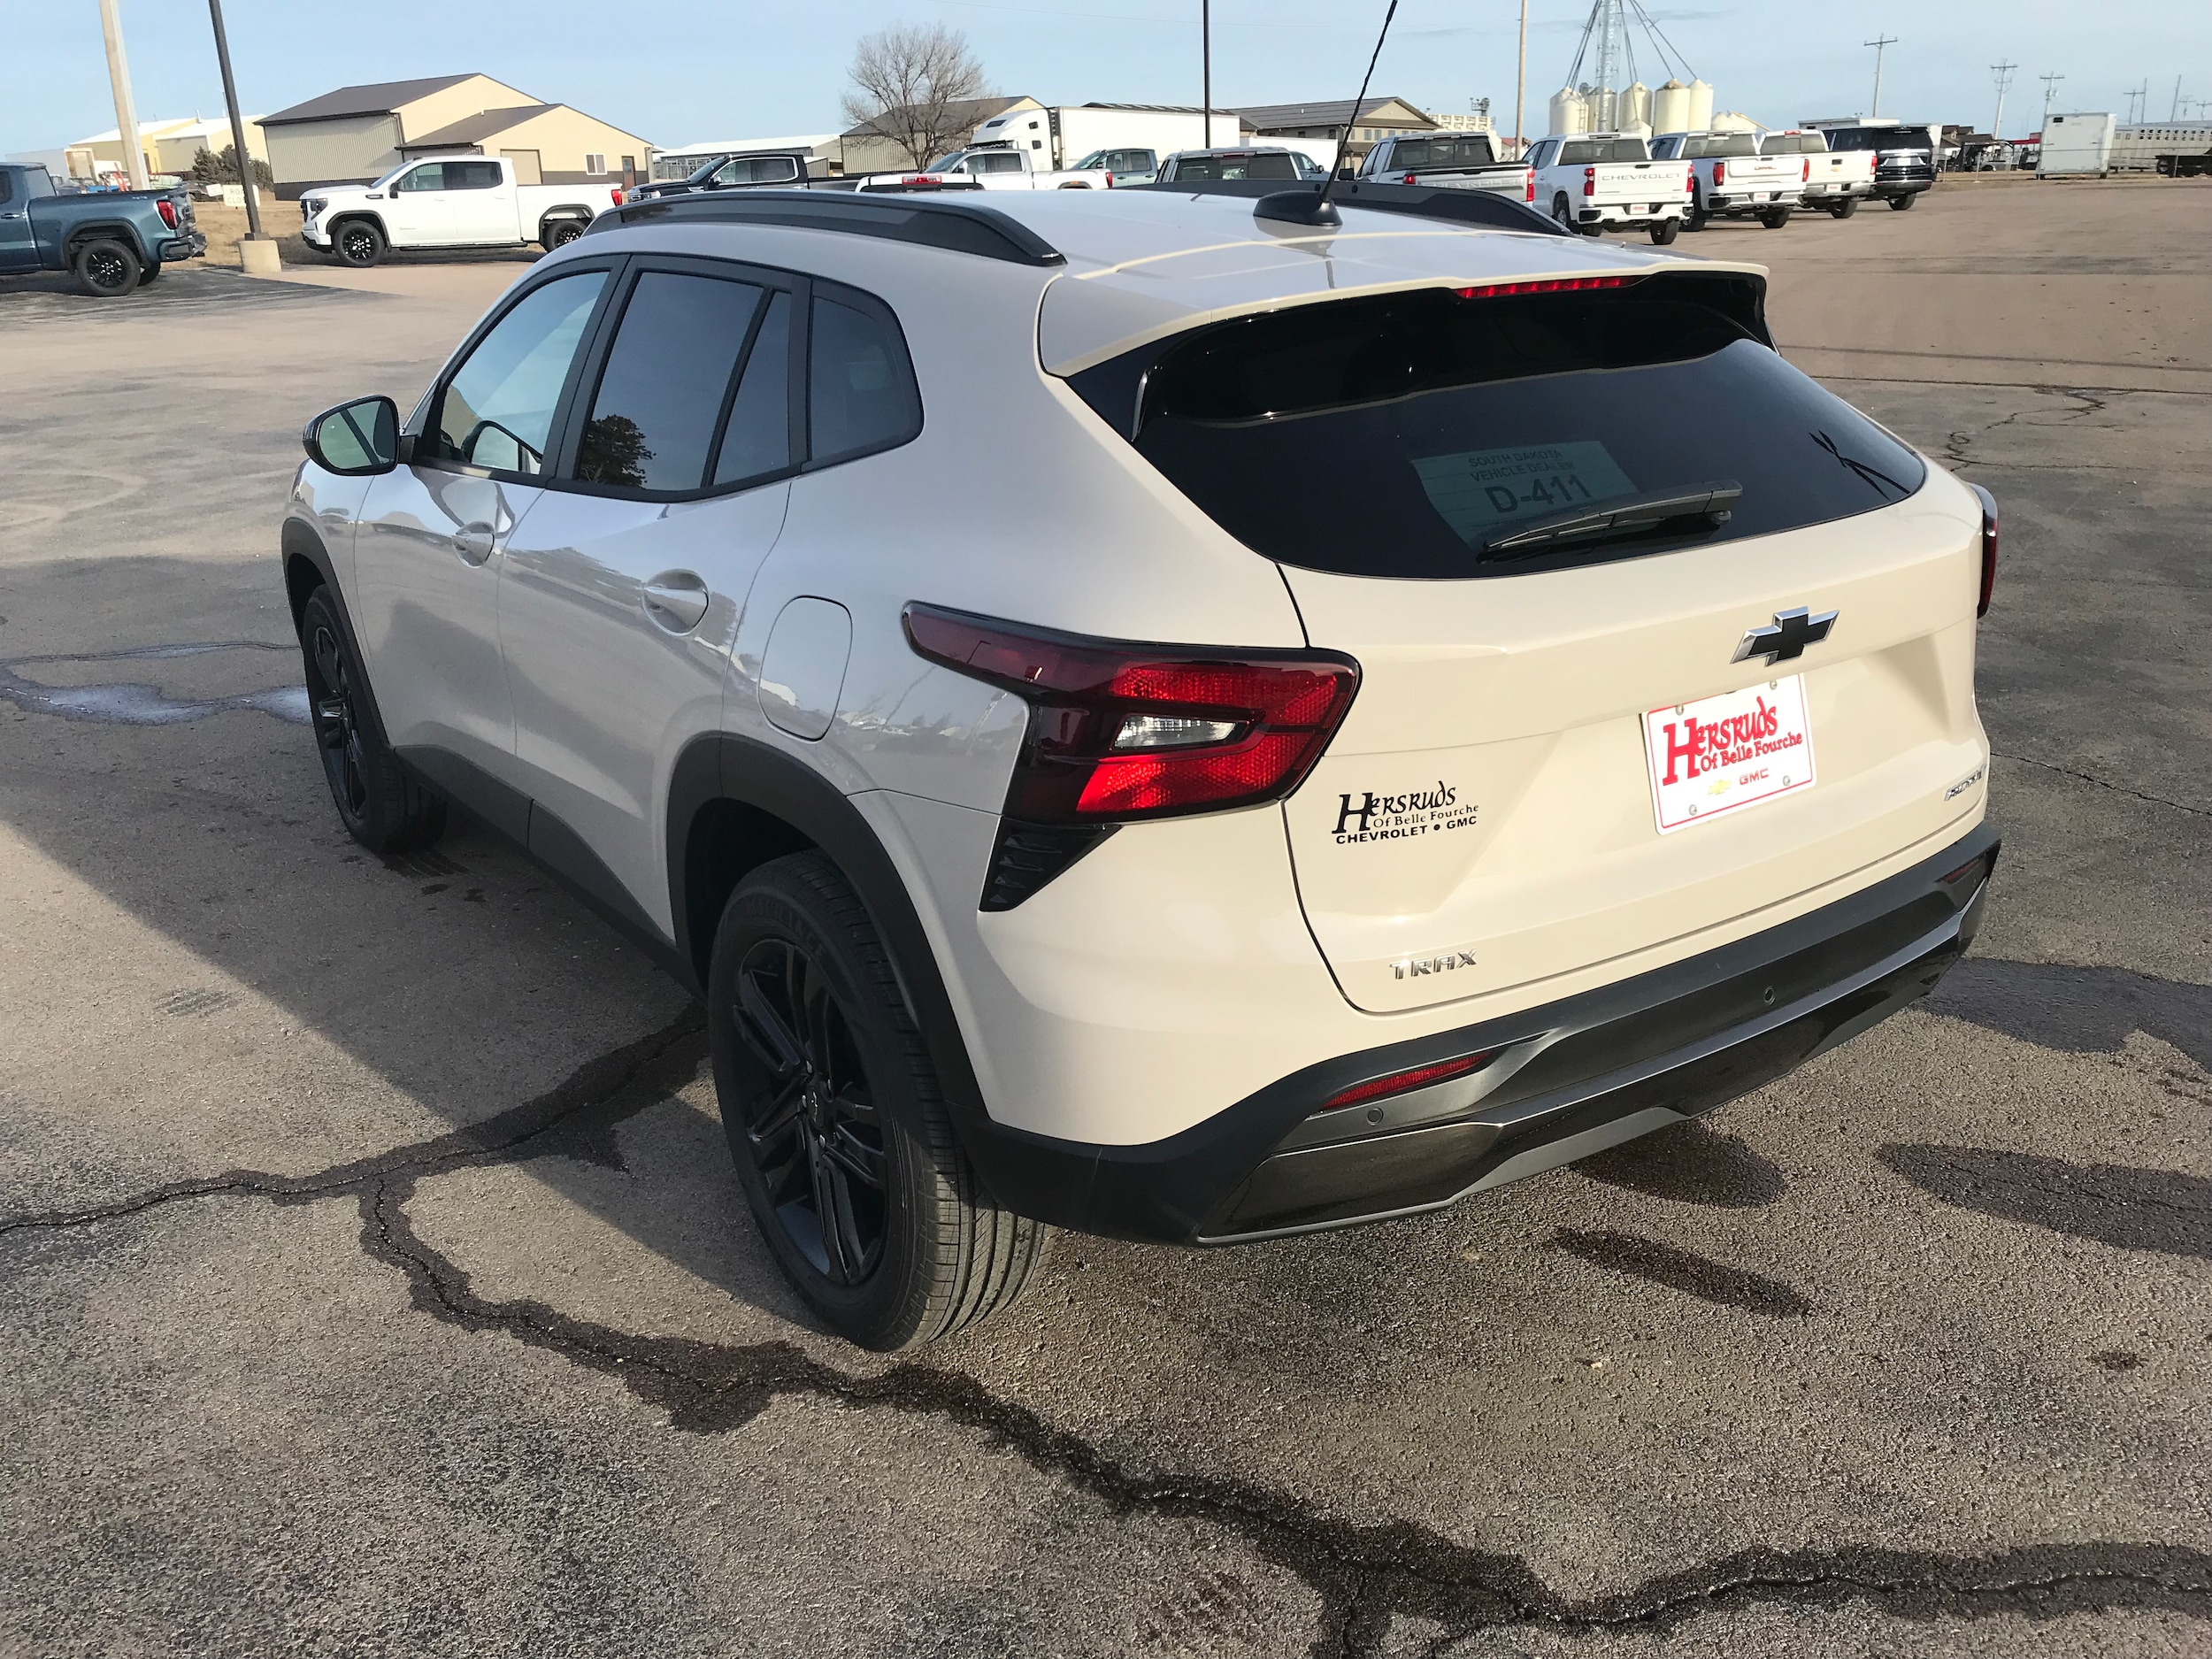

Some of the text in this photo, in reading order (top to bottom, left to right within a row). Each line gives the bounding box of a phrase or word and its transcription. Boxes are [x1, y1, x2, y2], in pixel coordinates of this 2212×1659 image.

[1601, 173, 1681, 181] CHEVROLET
[1468, 449, 1563, 468] SOUTH DAKOTA
[1471, 460, 1577, 482] VEHICLE DEALER
[1484, 473, 1592, 514] D-411
[1700, 731, 1803, 772] Of Belle Fourche
[1739, 767, 1770, 786] GMC
[1373, 804, 1479, 828] Of Belle Fourche
[1336, 816, 1477, 845] CHEVROLET GMC
[1389, 948, 1478, 980] TRAX
